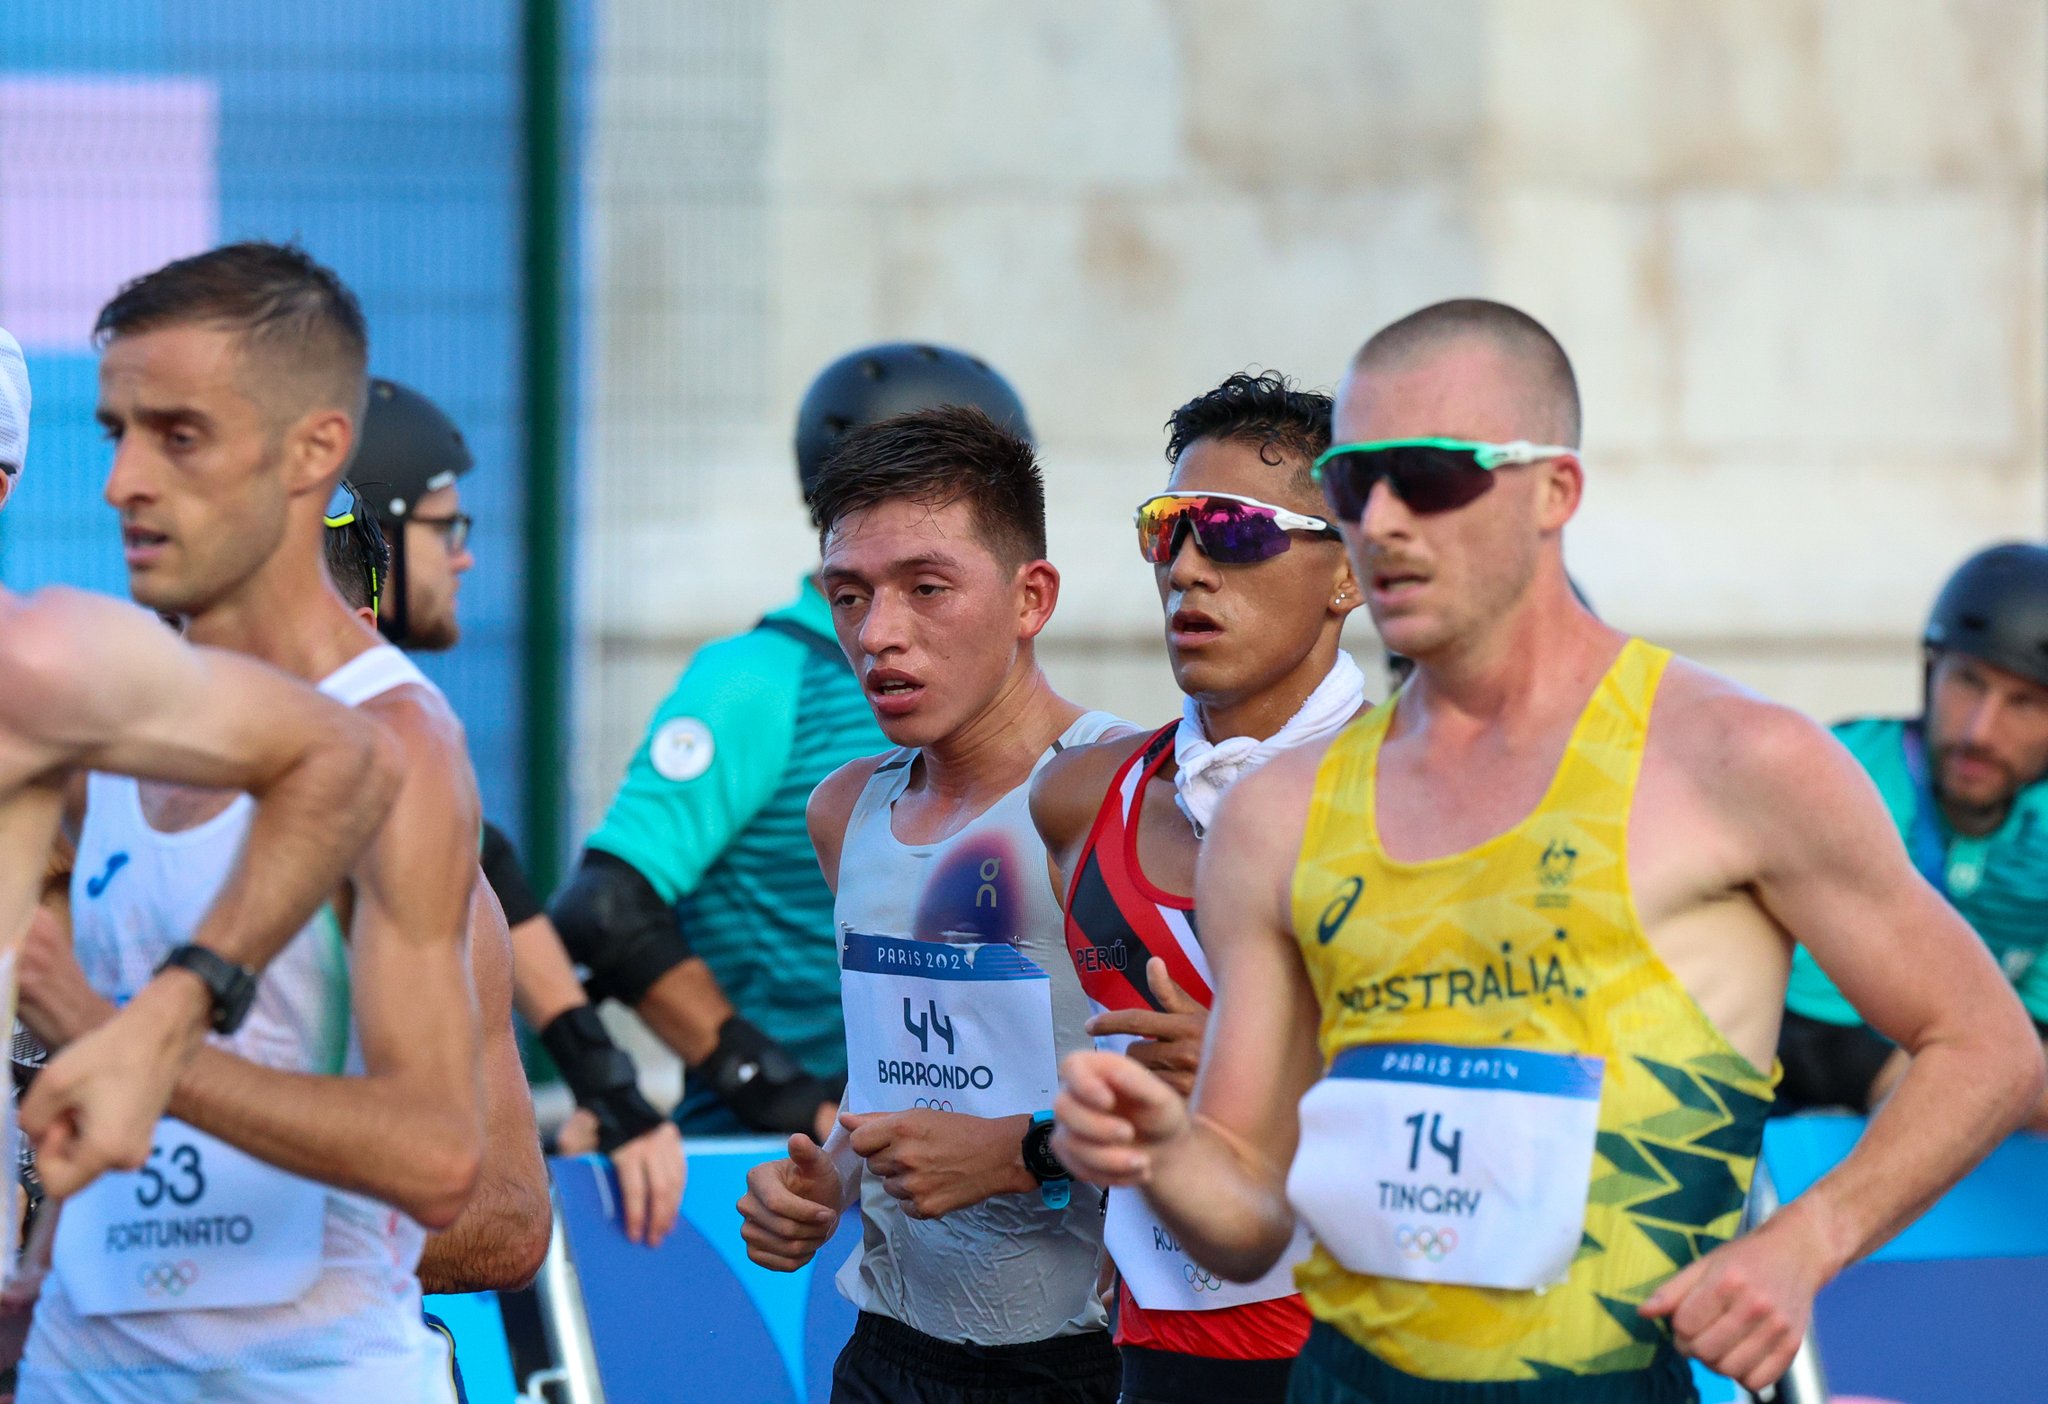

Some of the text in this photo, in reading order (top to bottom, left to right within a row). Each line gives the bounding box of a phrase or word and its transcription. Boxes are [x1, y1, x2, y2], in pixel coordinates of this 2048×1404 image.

[1076, 938, 1128, 974] PERÚ
[903, 997, 955, 1055] 44
[877, 1059, 994, 1090] BARRONDO
[1404, 1110, 1462, 1174] 14
[135, 1143, 206, 1209] 53
[1378, 1181, 1483, 1217] TINGAY
[105, 1214, 254, 1253] FORTUNATO
